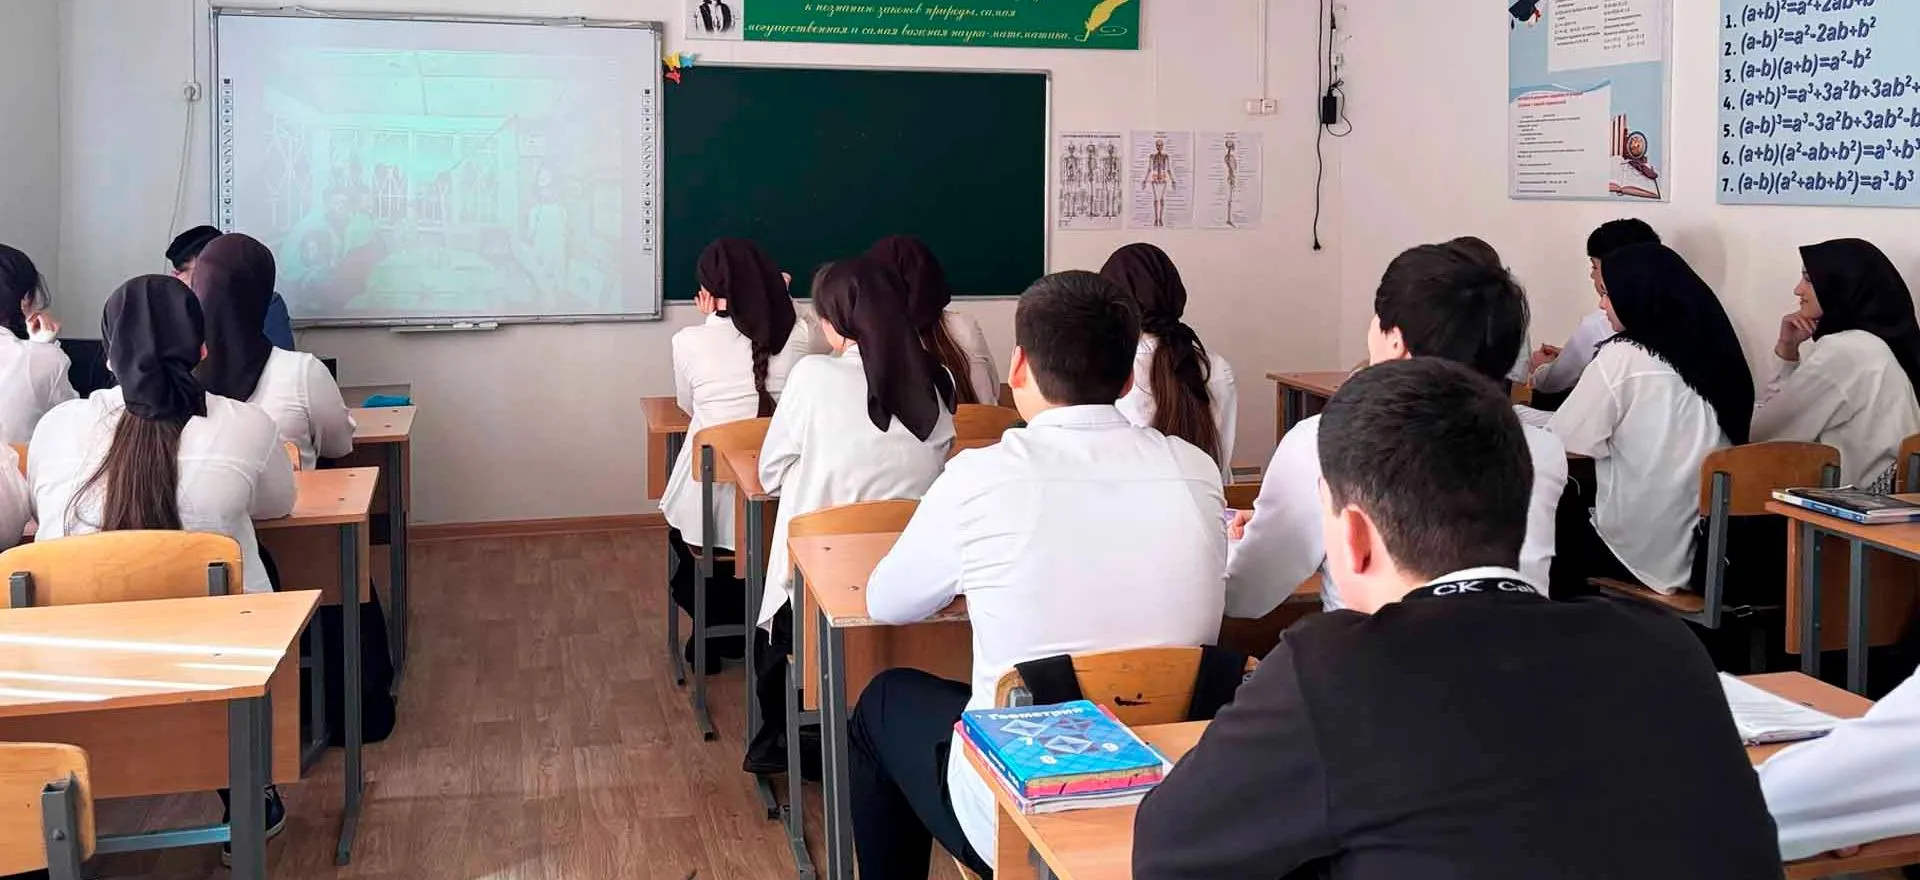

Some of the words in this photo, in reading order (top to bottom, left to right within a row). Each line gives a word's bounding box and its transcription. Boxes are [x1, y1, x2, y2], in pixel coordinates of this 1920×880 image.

[877, 3, 923, 18] законов
[980, 8, 1016, 17] самая
[745, 20, 849, 37] могущественная
[861, 27, 898, 36] самая
[901, 23, 948, 37] важная
[1725, 14, 1737, 29] 1.
[1724, 42, 1737, 56] 2.
[1724, 69, 1736, 83] 3.
[1723, 96, 1735, 110] 4.
[1723, 123, 1735, 138] 5.
[1722, 151, 1734, 165] 6.
[1722, 178, 1734, 192] 7.
[1433, 580, 1484, 596] CK
[988, 707, 1084, 720] Геометрия
